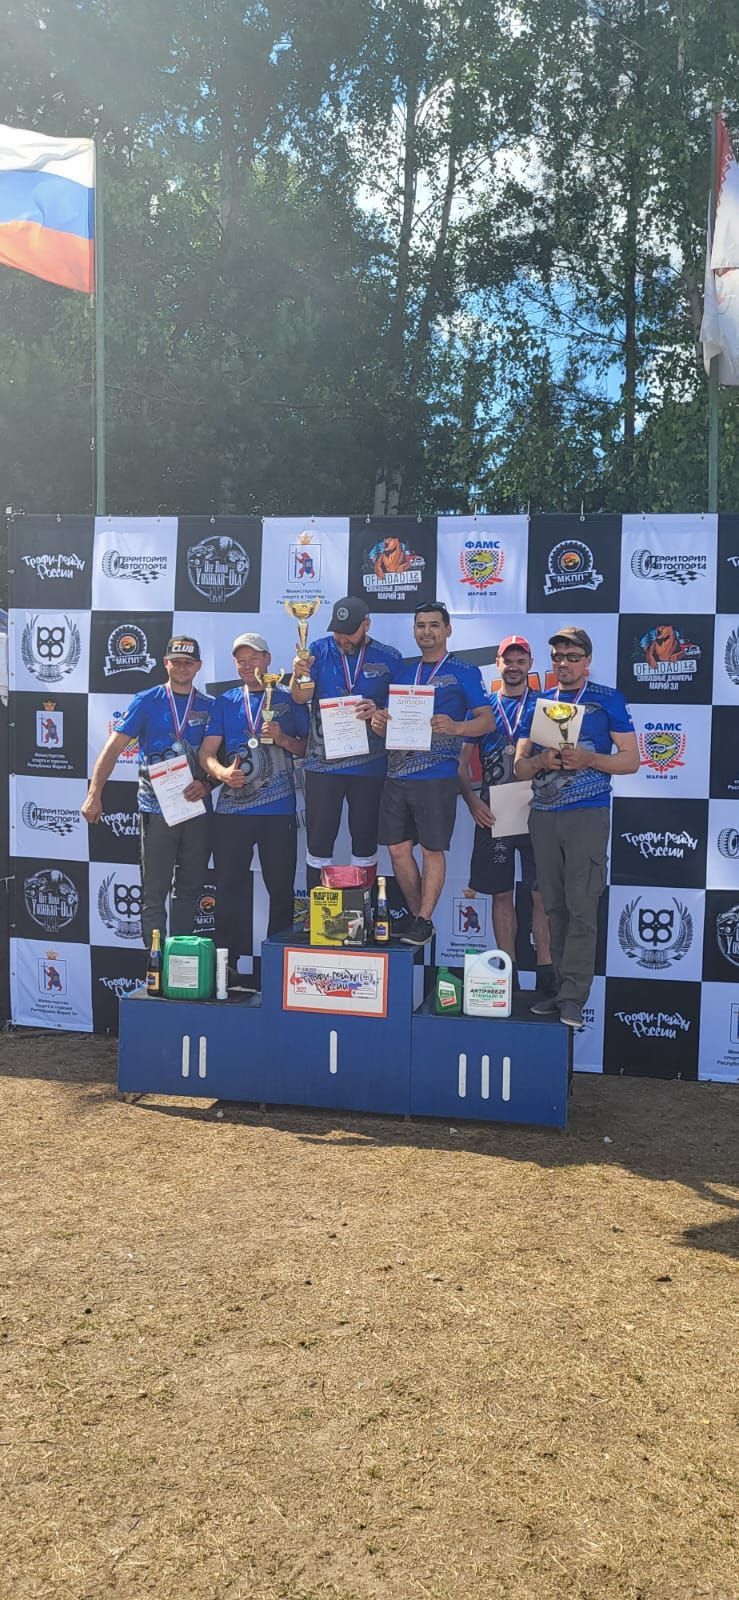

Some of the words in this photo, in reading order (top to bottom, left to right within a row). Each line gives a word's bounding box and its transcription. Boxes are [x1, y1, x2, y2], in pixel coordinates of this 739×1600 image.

[464, 540, 500, 549] ФАМС
[37, 563, 74, 580] России
[651, 562, 707, 570] АВТОСПОРТА
[366, 573, 405, 586] OFROAD
[171, 644, 195, 653] CLUB
[636, 662, 679, 675] OFROAD
[683, 661, 695, 669] 12
[649, 681, 670, 690] МАРИЙ
[670, 682, 678, 690] ЭЛ
[644, 722, 682, 731] ФАМС
[620, 830, 698, 850] Трофи-рейды
[639, 840, 684, 859] России
[313, 891, 339, 900] RAPTOR
[614, 1011, 691, 1032] Трофи-рейды
[632, 1021, 677, 1040] России
[458, 1053, 511, 1102] III
